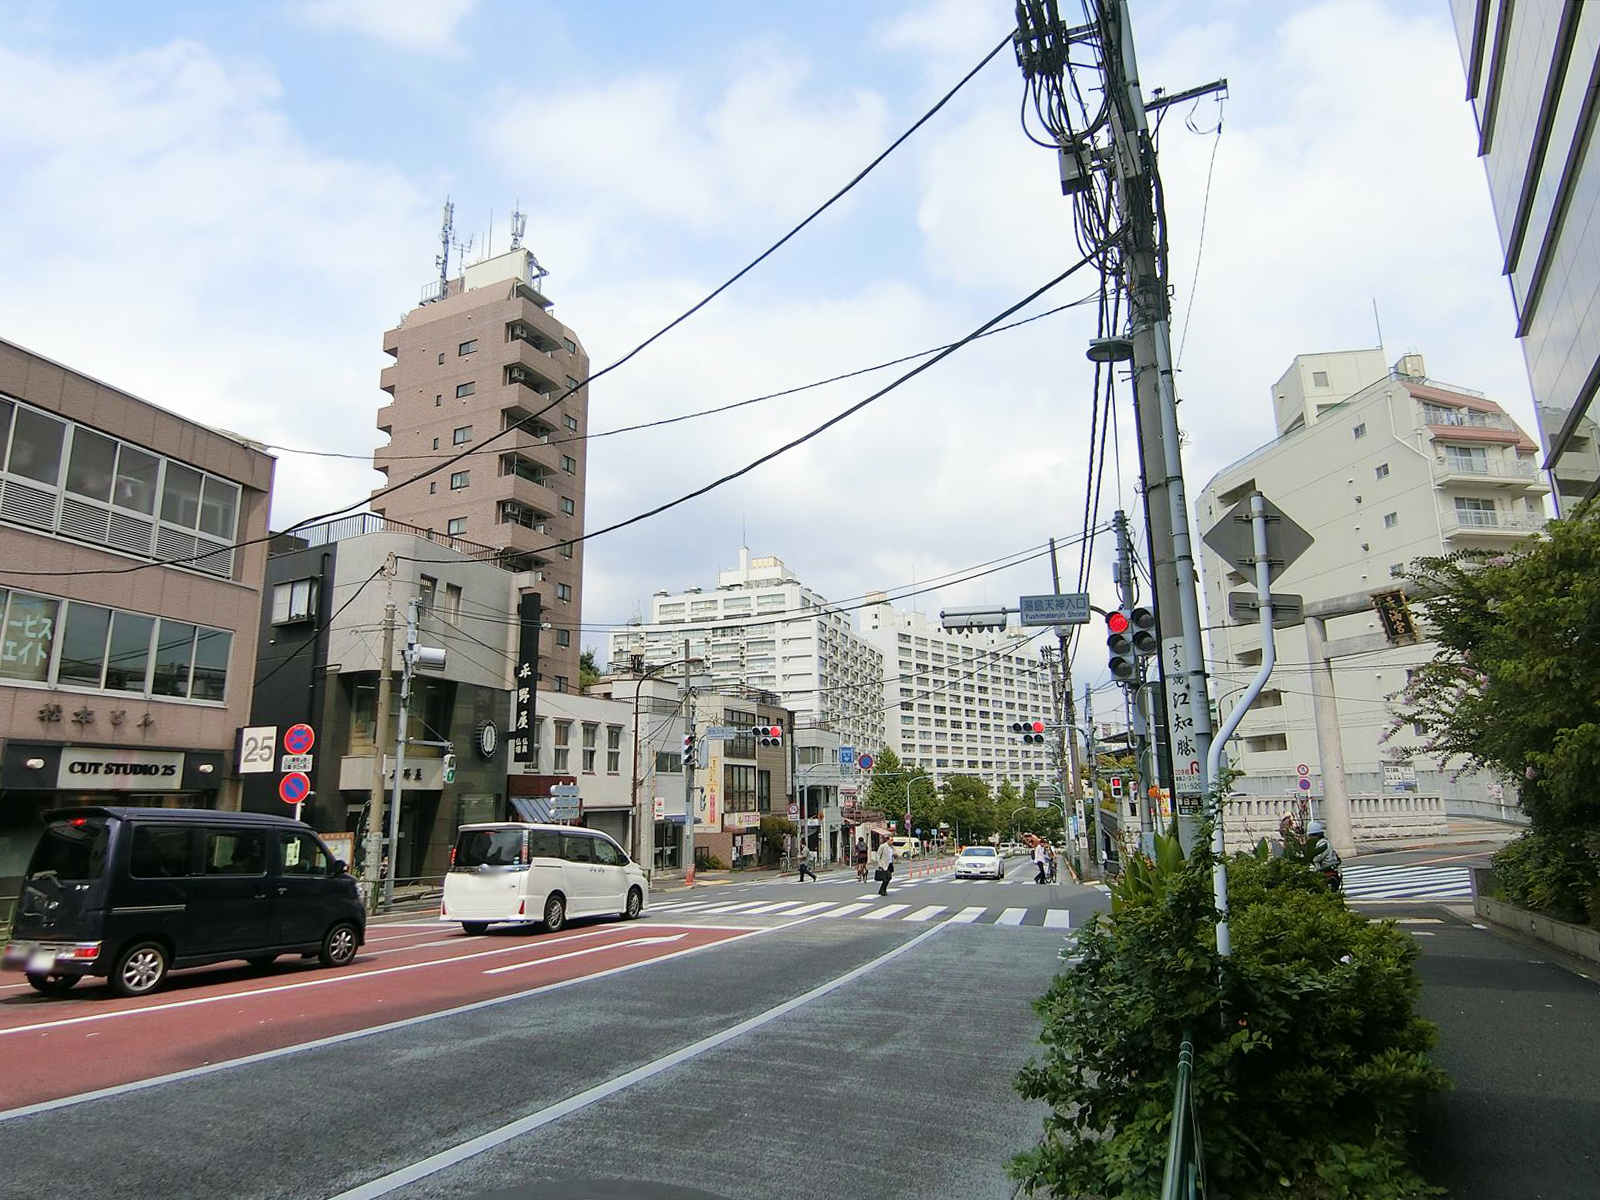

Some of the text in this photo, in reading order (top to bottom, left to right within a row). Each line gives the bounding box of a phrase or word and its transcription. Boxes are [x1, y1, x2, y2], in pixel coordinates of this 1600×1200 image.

[1023, 597, 1087, 612] 湯島天神入口
[0, 614, 52, 640] ービス
[517, 662, 532, 730] 平野屋
[37, 702, 155, 728] 松本ビル
[243, 735, 274, 763] 25
[69, 761, 177, 776] CUT STUDIO 25
